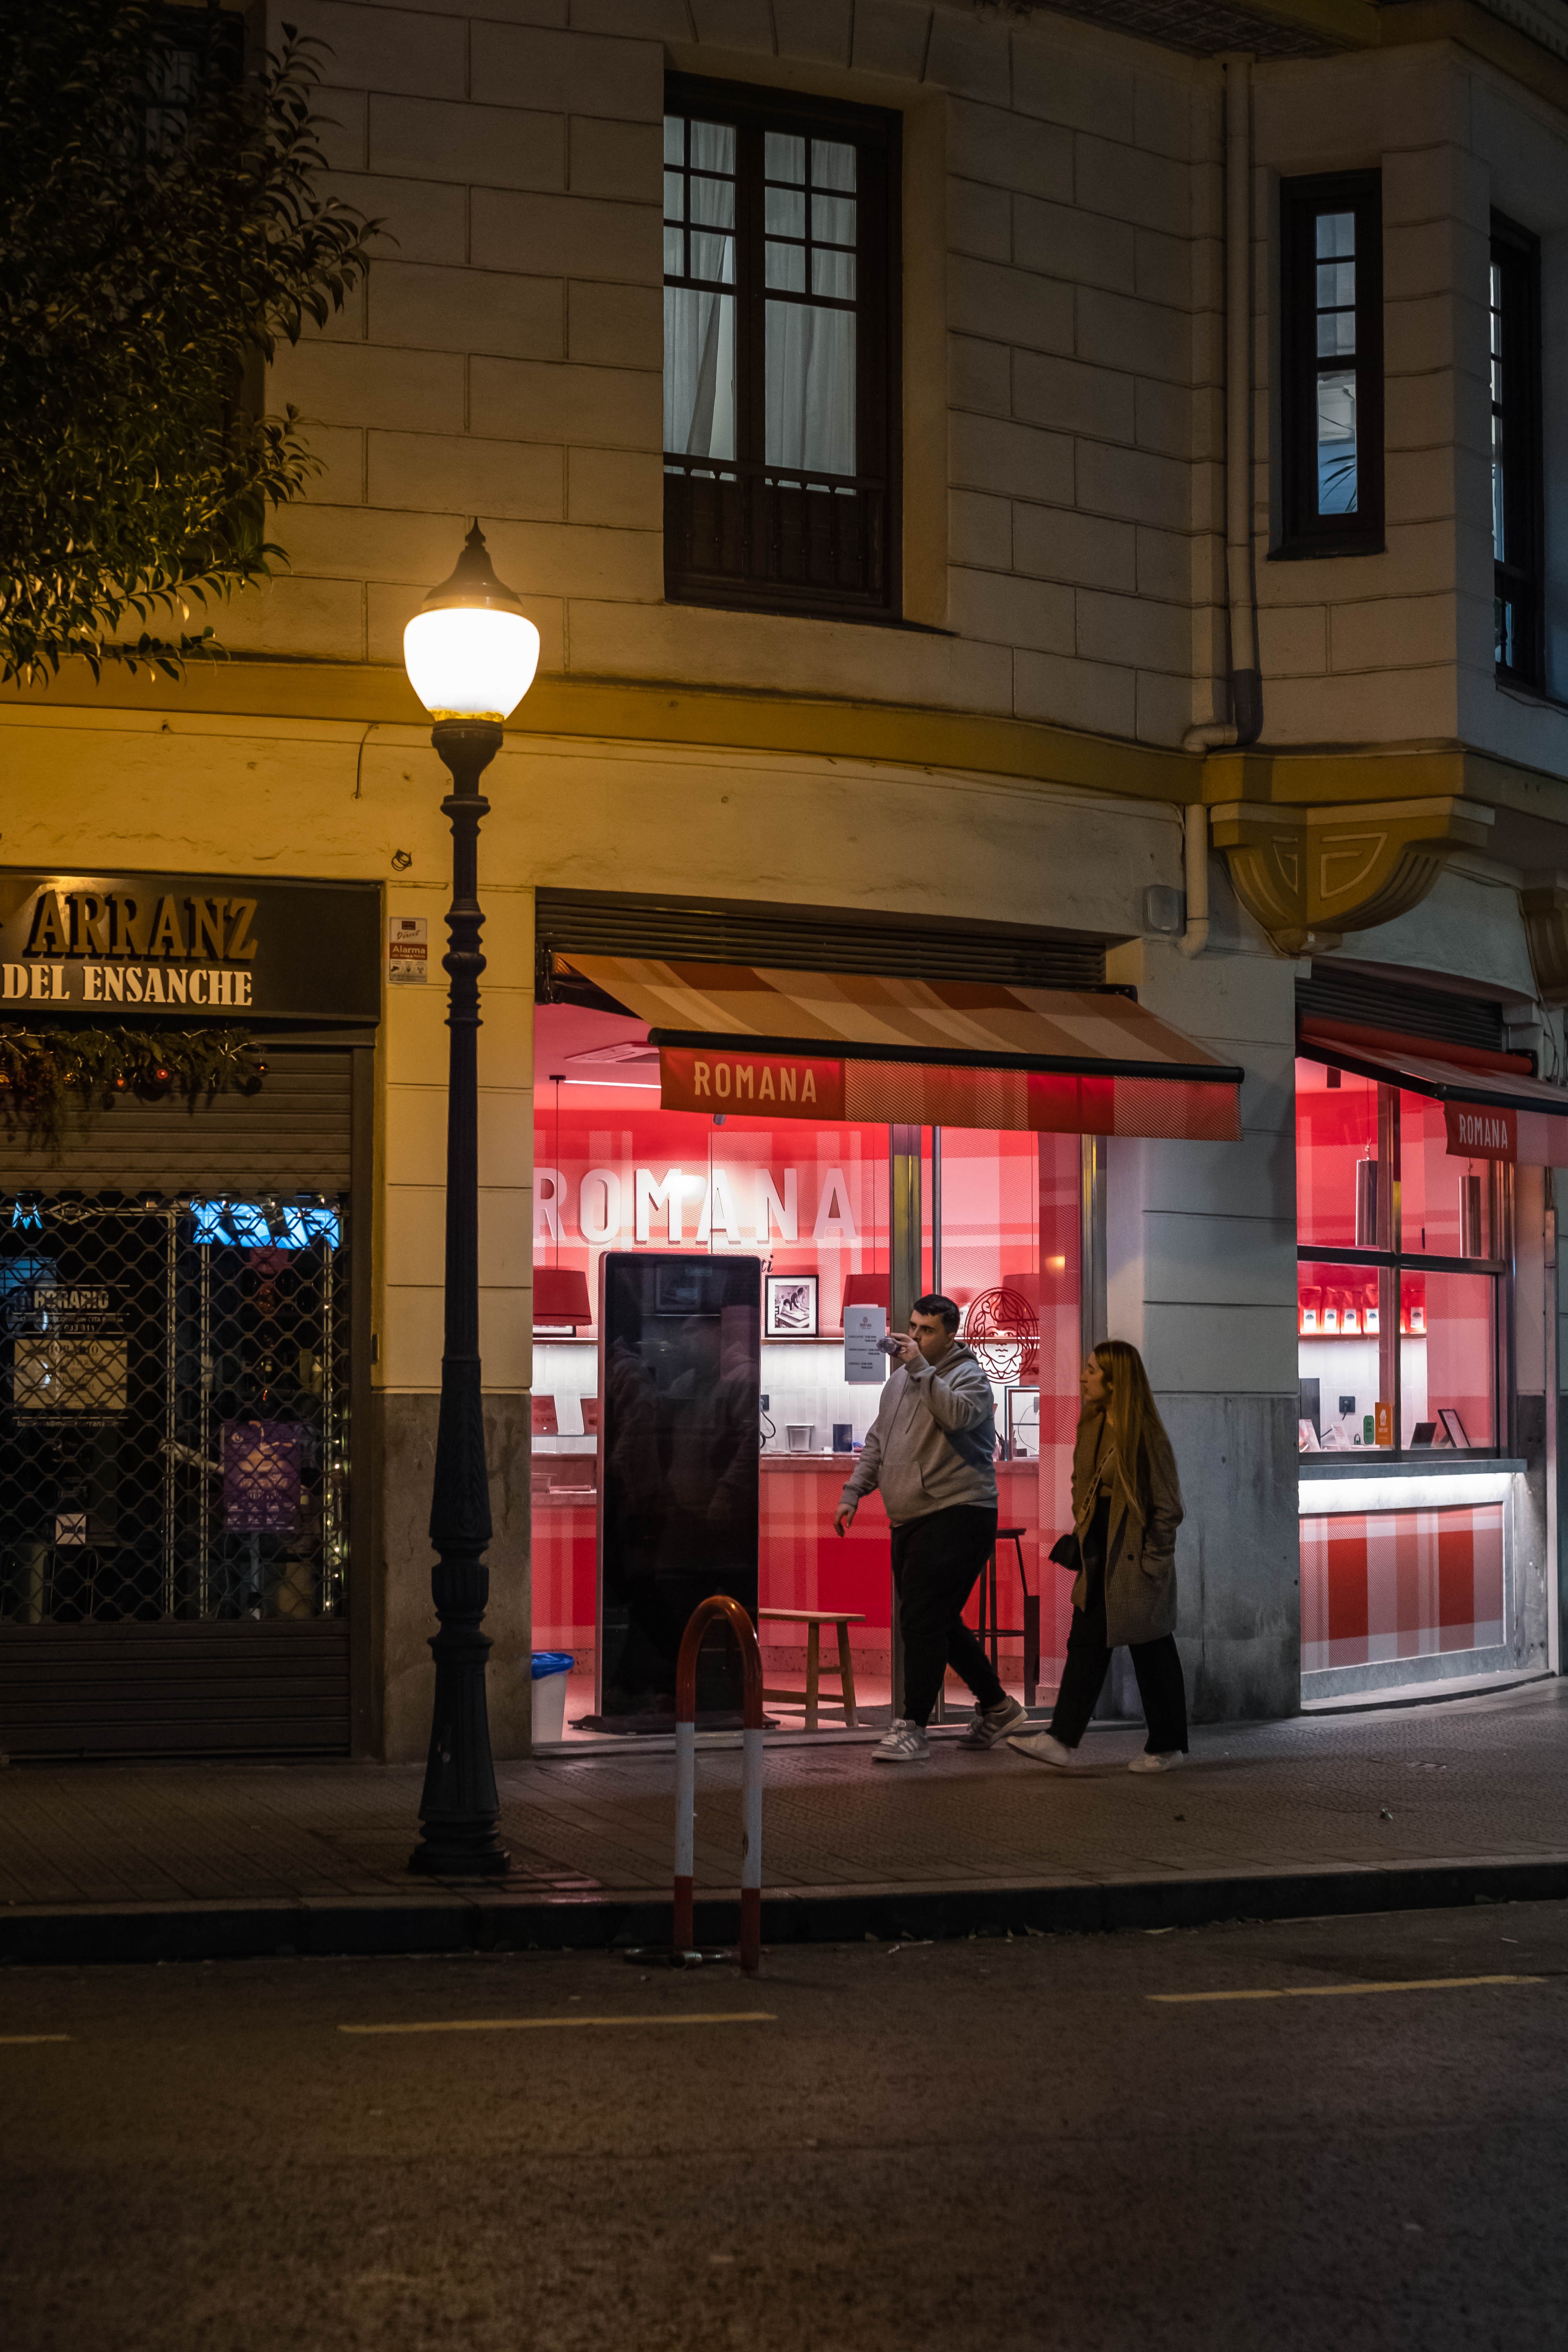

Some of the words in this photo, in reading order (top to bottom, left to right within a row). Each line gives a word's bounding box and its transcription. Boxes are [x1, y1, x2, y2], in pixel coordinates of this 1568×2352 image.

[31, 888, 259, 960] ARRANZ
[392, 945, 426, 954] Alarma
[2, 964, 70, 1000] DEL
[82, 965, 253, 1006] ENSANCHE
[694, 1061, 817, 1103] ROMANA
[1459, 1114, 1508, 1149] ROMANA
[533, 1167, 857, 1243] ROMANA
